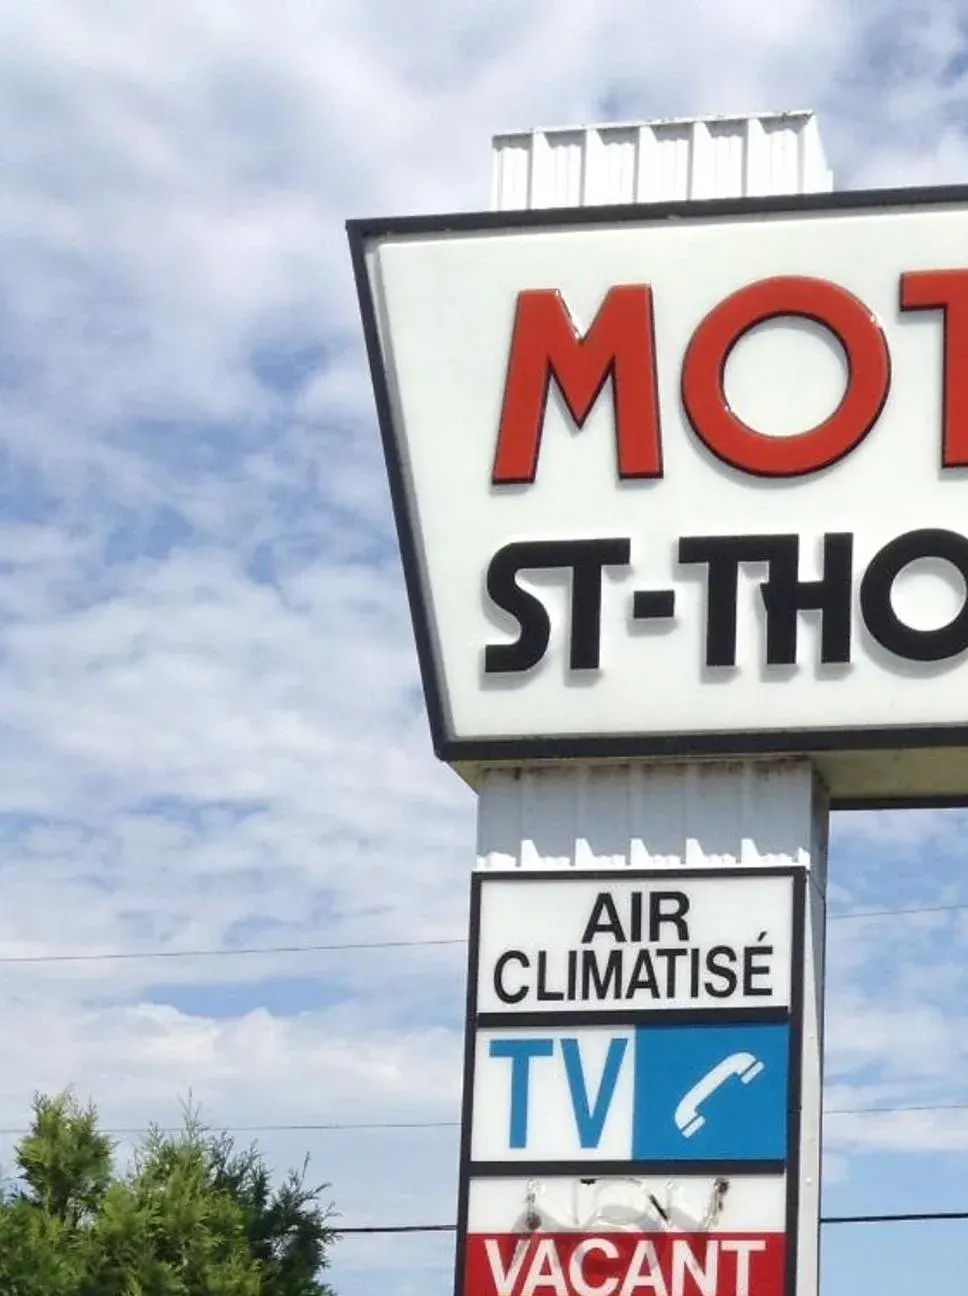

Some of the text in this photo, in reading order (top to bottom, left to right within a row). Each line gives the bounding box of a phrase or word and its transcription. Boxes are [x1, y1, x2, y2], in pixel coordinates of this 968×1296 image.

[581, 890, 690, 943] AIR
[493, 931, 774, 1004] CLIMATISÉ
[489, 1037, 628, 1149] TV
